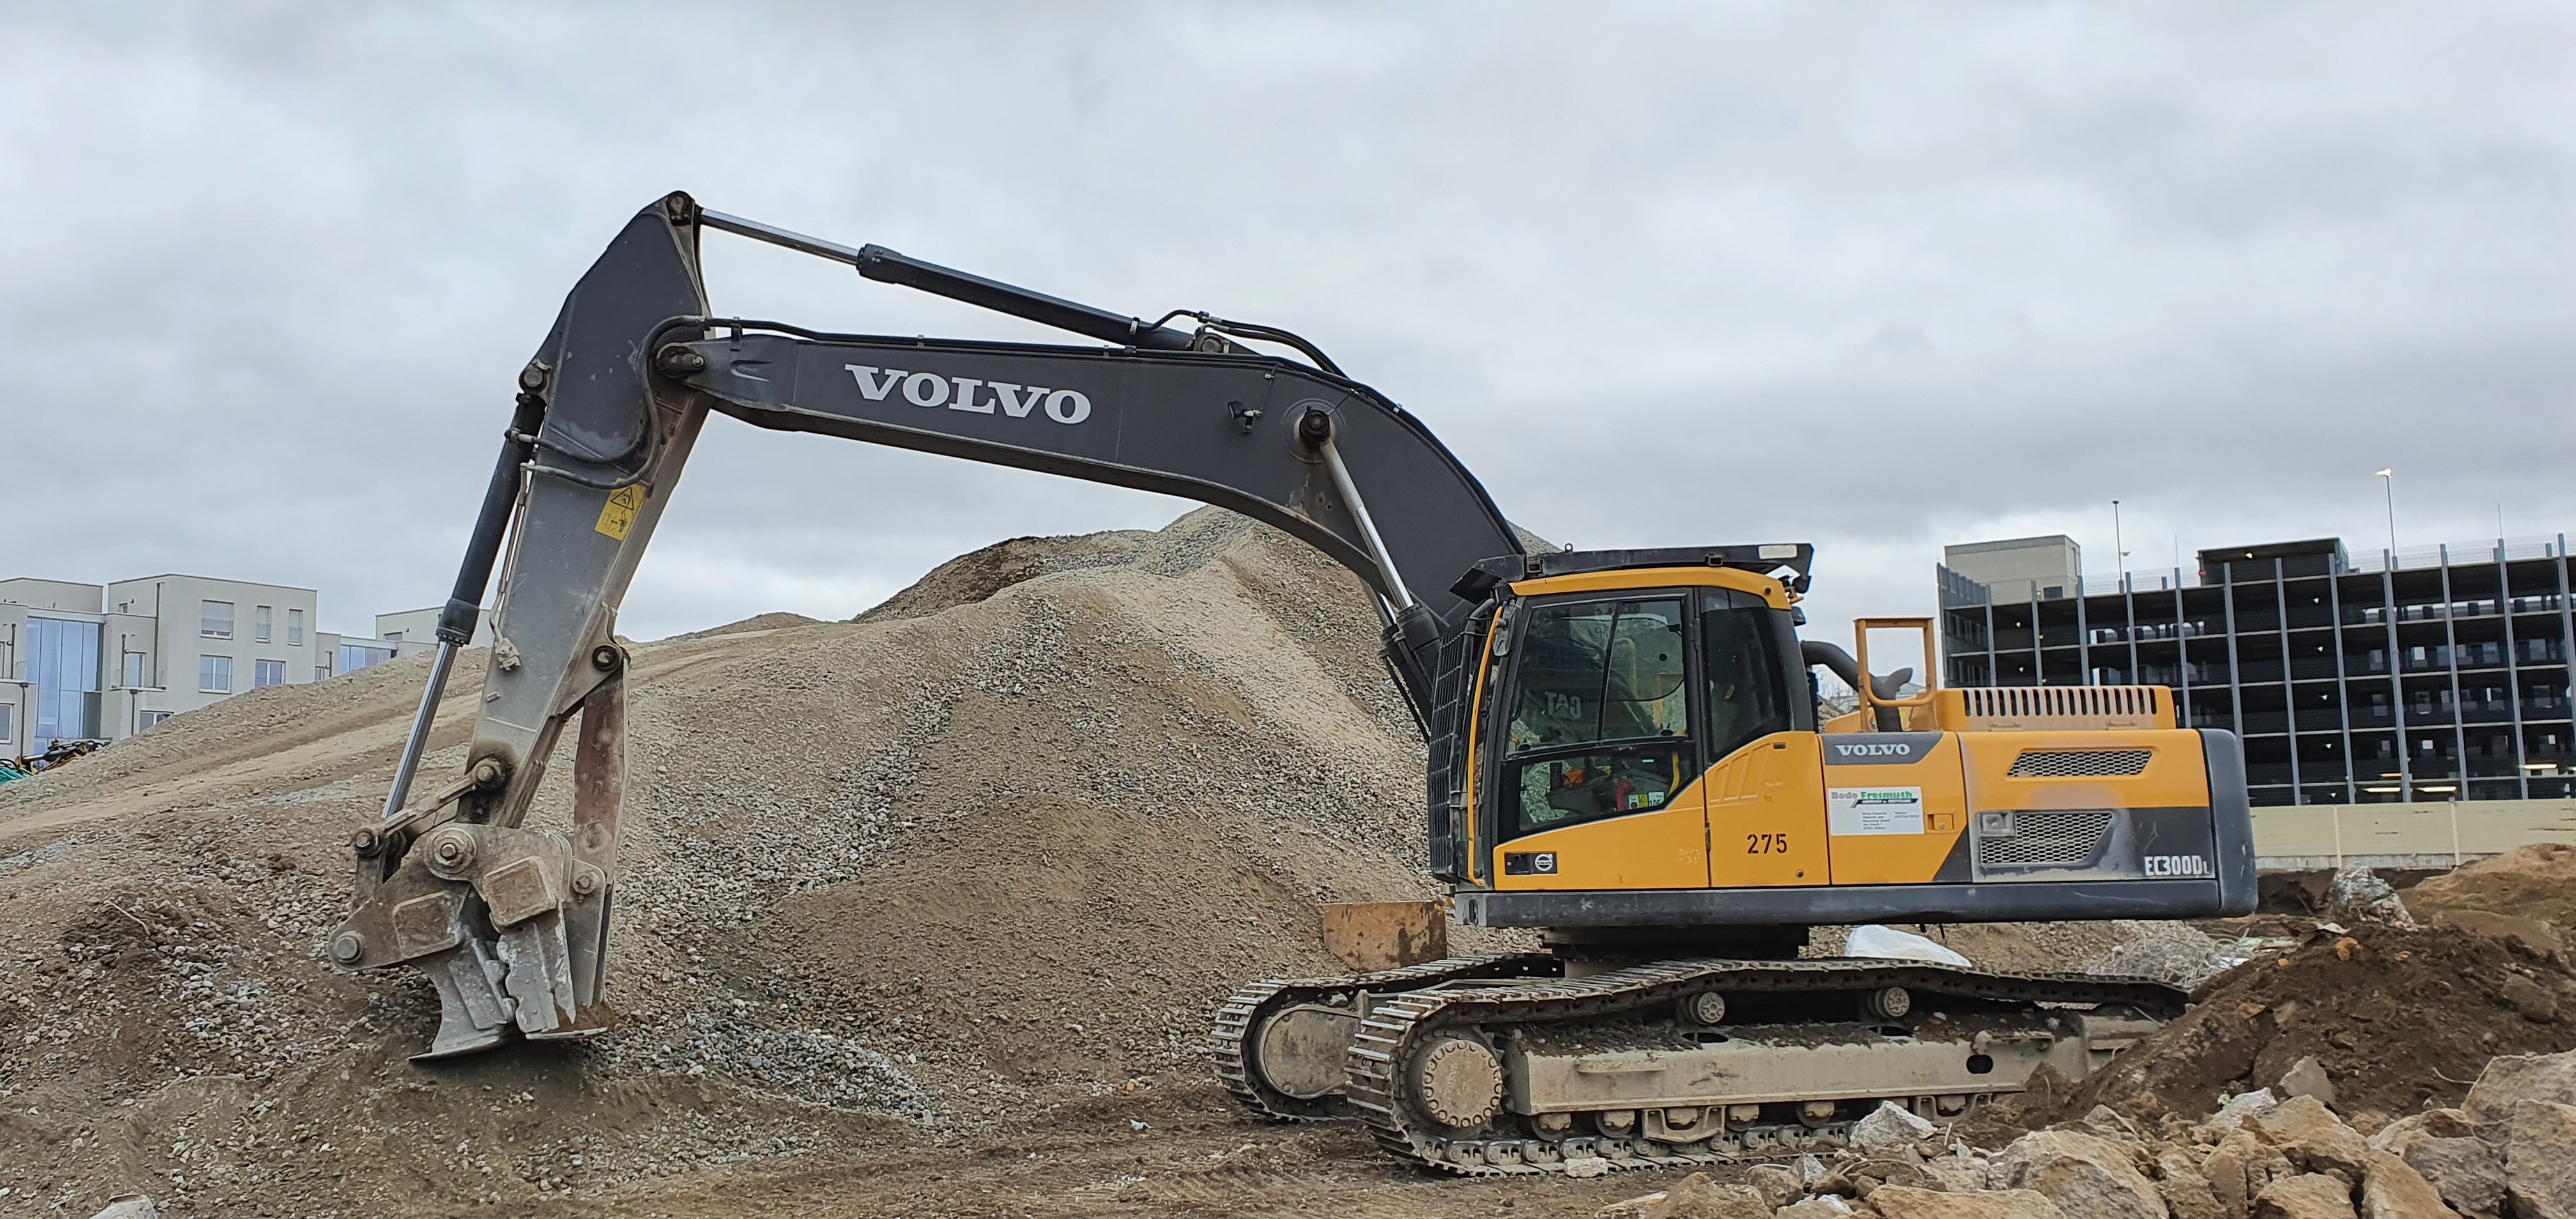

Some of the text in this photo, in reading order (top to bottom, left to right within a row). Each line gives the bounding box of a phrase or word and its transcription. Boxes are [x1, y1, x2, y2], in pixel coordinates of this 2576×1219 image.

[845, 364, 1091, 424] VOLVO
[1835, 744, 1910, 756] VOLVO
[1747, 833, 1787, 854] 275
